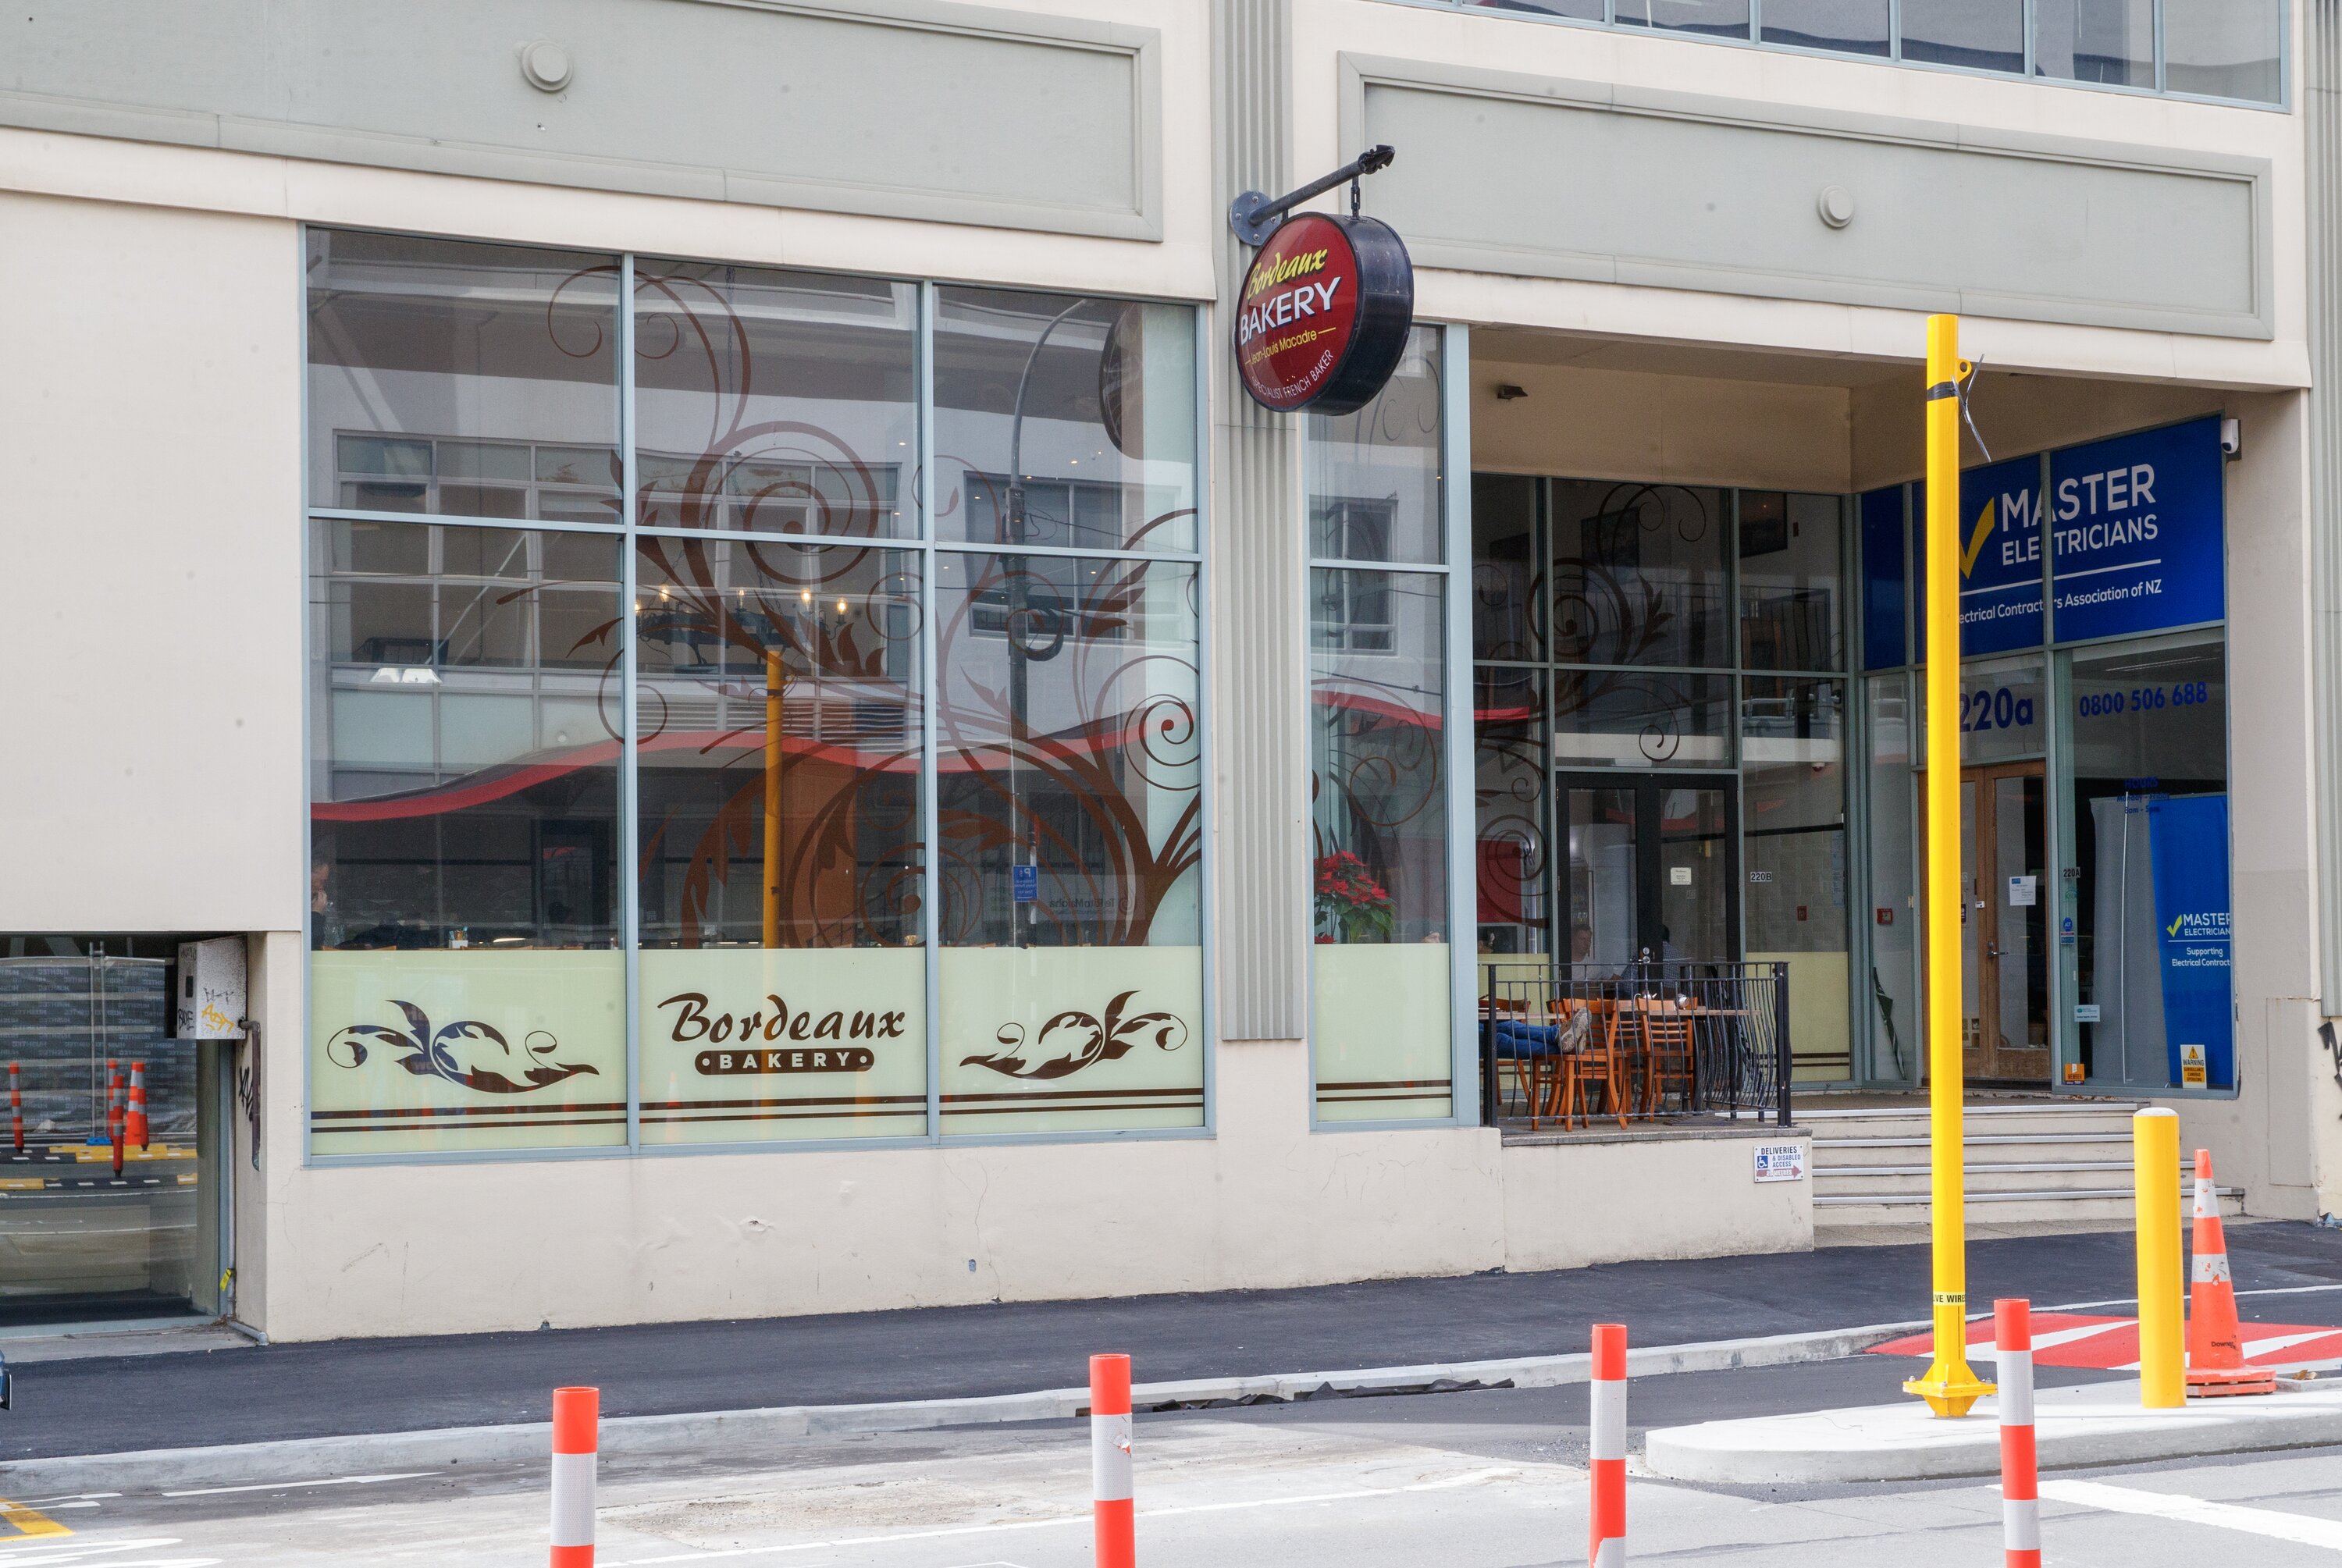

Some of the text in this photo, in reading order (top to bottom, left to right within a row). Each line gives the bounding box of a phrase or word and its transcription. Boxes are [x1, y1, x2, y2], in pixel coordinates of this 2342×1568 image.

[1247, 248, 1328, 300] Bordeaux
[1240, 276, 1341, 345] BAKERY
[1251, 329, 1317, 364] Jean-Louis Macadre
[1252, 349, 1333, 399] SPECIALIST FRENCH BAKER
[2003, 514, 2159, 566] ELETRICIANS
[1959, 579, 2162, 624] ectrical Contracts Association of NZ
[1959, 687, 2033, 732] 220a
[2080, 681, 2207, 717] 0800 506 688
[2124, 776, 2159, 788] HOURS
[1751, 873, 1772, 881] 220B
[2063, 869, 2080, 877] 220A
[2187, 948, 2223, 957] Supporting
[657, 992, 906, 1043] Bordeaux
[719, 1052, 850, 1069] BAKERY
[1761, 1147, 1797, 1155] DELIVERIES
